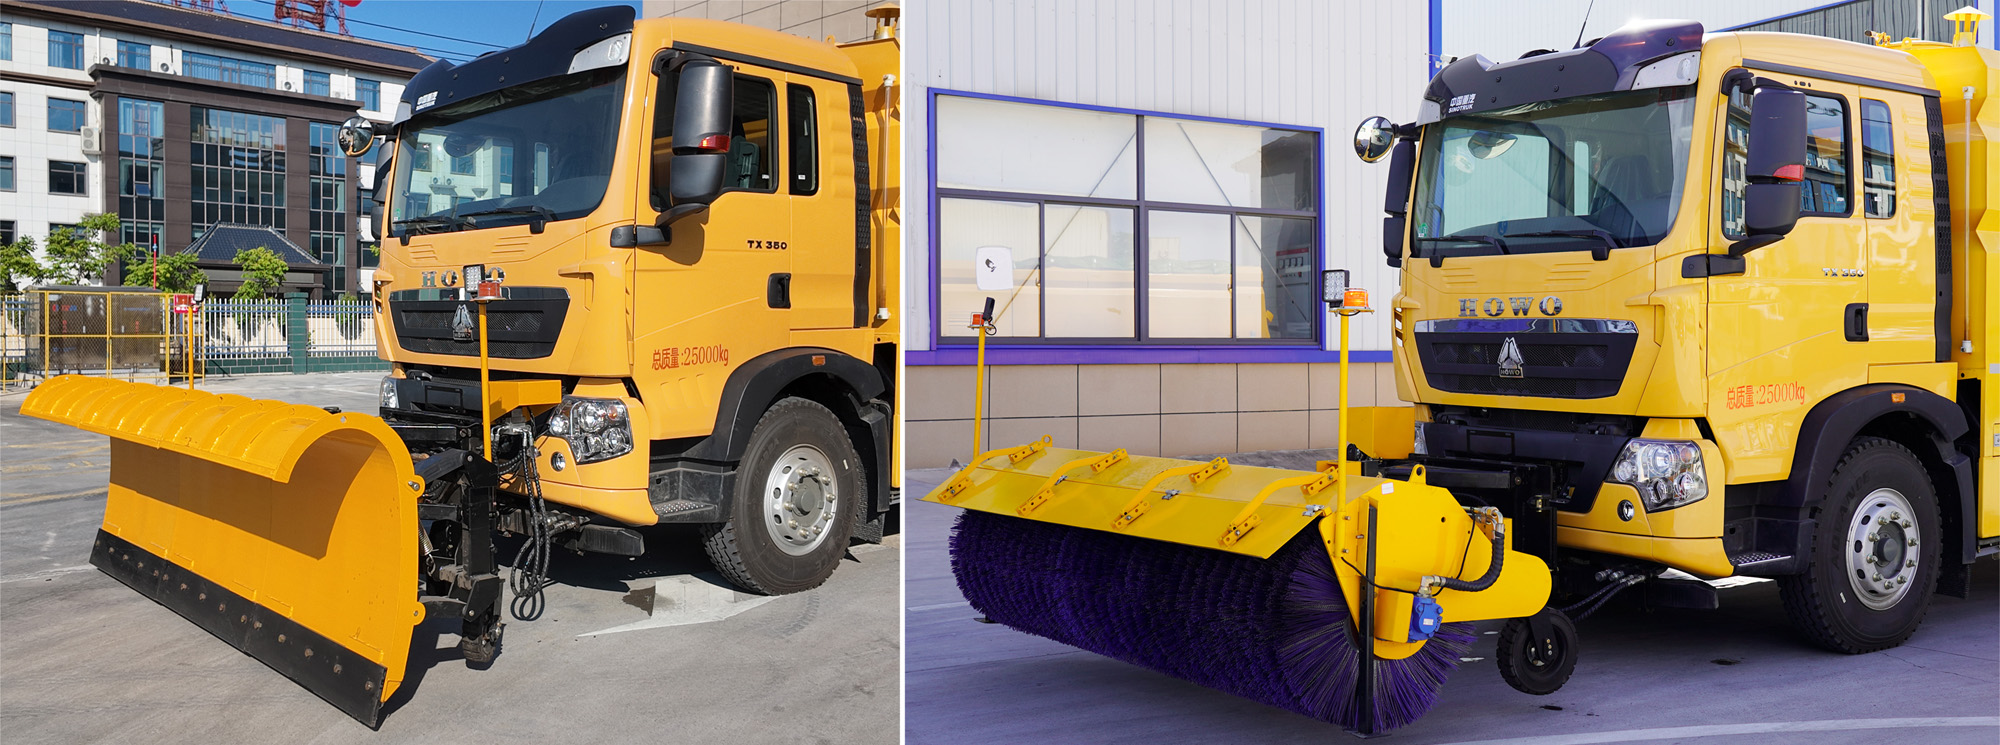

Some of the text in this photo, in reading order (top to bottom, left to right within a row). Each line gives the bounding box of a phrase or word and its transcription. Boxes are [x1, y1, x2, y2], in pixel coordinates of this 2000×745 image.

[747, 240, 788, 250] TX 350
[421, 266, 506, 287] HOO
[1822, 267, 1865, 278] TX 350
[1458, 295, 1563, 317] HOWO
